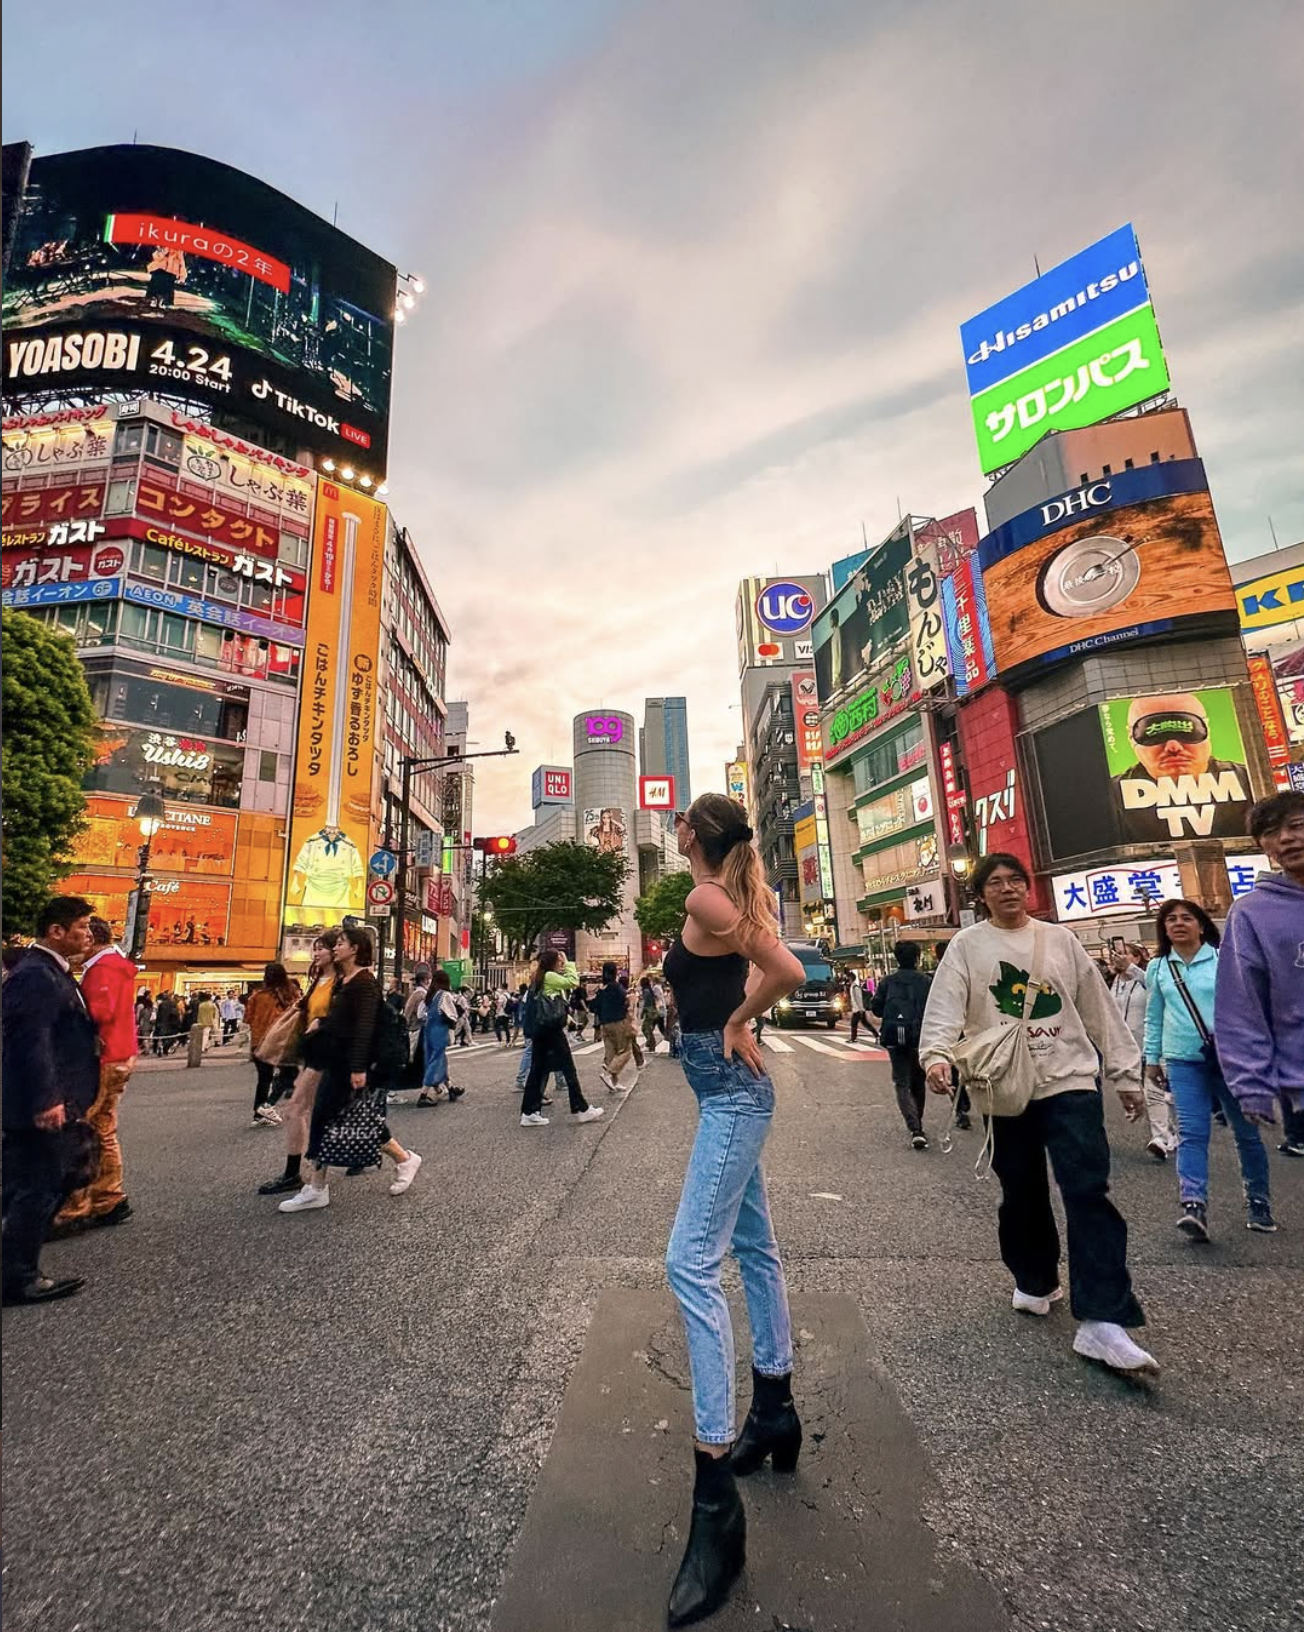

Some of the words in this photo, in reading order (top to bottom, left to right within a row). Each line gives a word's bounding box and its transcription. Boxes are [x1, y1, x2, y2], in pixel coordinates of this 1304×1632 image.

[139, 222, 273, 277] ikuraの2年
[968, 261, 1138, 365] Hisamitsu
[9, 332, 140, 378] YOASOBI
[151, 341, 232, 381] 4.24
[150, 364, 190, 381] 20:00
[195, 374, 231, 393] Start
[985, 339, 1149, 442] サロンパス
[275, 390, 339, 435] TikTok
[38, 435, 107, 462] しゃぶ葉
[346, 427, 366, 444] LIVE
[230, 465, 307, 511] しゃぶ葉
[1041, 481, 1113, 526] DHC
[138, 485, 275, 547] コンタクト
[47, 521, 106, 545] ガスト
[12, 556, 83, 587] ガスト
[232, 554, 293, 586] ガスト
[133, 586, 175, 606] AEON
[908, 557, 947, 677] もんじゃ
[1069, 640, 1094, 653] DHC
[1095, 628, 1139, 646] Channel
[585, 716, 623, 743] 109
[548, 775, 566, 784] UNI
[548, 785, 567, 794] QLO
[1120, 771, 1246, 809] DMM
[1157, 805, 1215, 837] TV
[143, 880, 180, 894] Café
[1064, 865, 1255, 911] 大盛堂店
